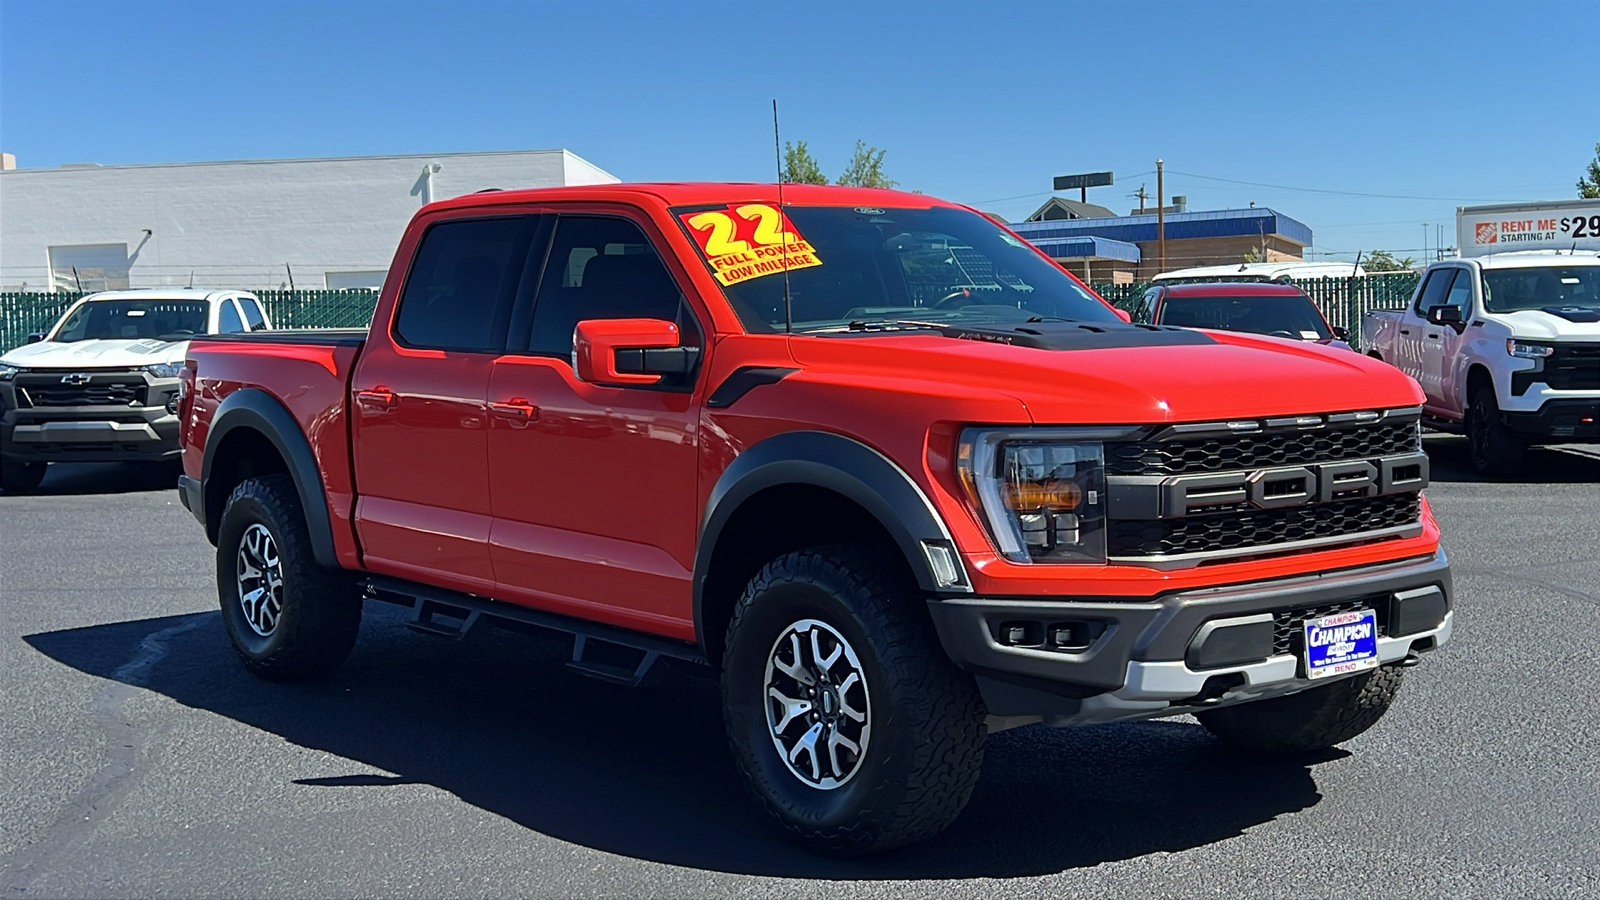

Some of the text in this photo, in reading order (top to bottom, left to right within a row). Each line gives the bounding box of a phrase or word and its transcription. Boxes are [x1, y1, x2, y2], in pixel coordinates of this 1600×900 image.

[688, 204, 799, 257] 22
[1501, 218, 1557, 232] RENT ME
[1501, 232, 1543, 242] STARTING
[1545, 231, 1556, 240] AT
[713, 242, 810, 269] FULL POWER
[722, 253, 815, 283] LOW MILEAGE
[1160, 452, 1429, 518] FORD
[1324, 614, 1357, 626] CHAMPION
[1334, 663, 1357, 673] RENO
